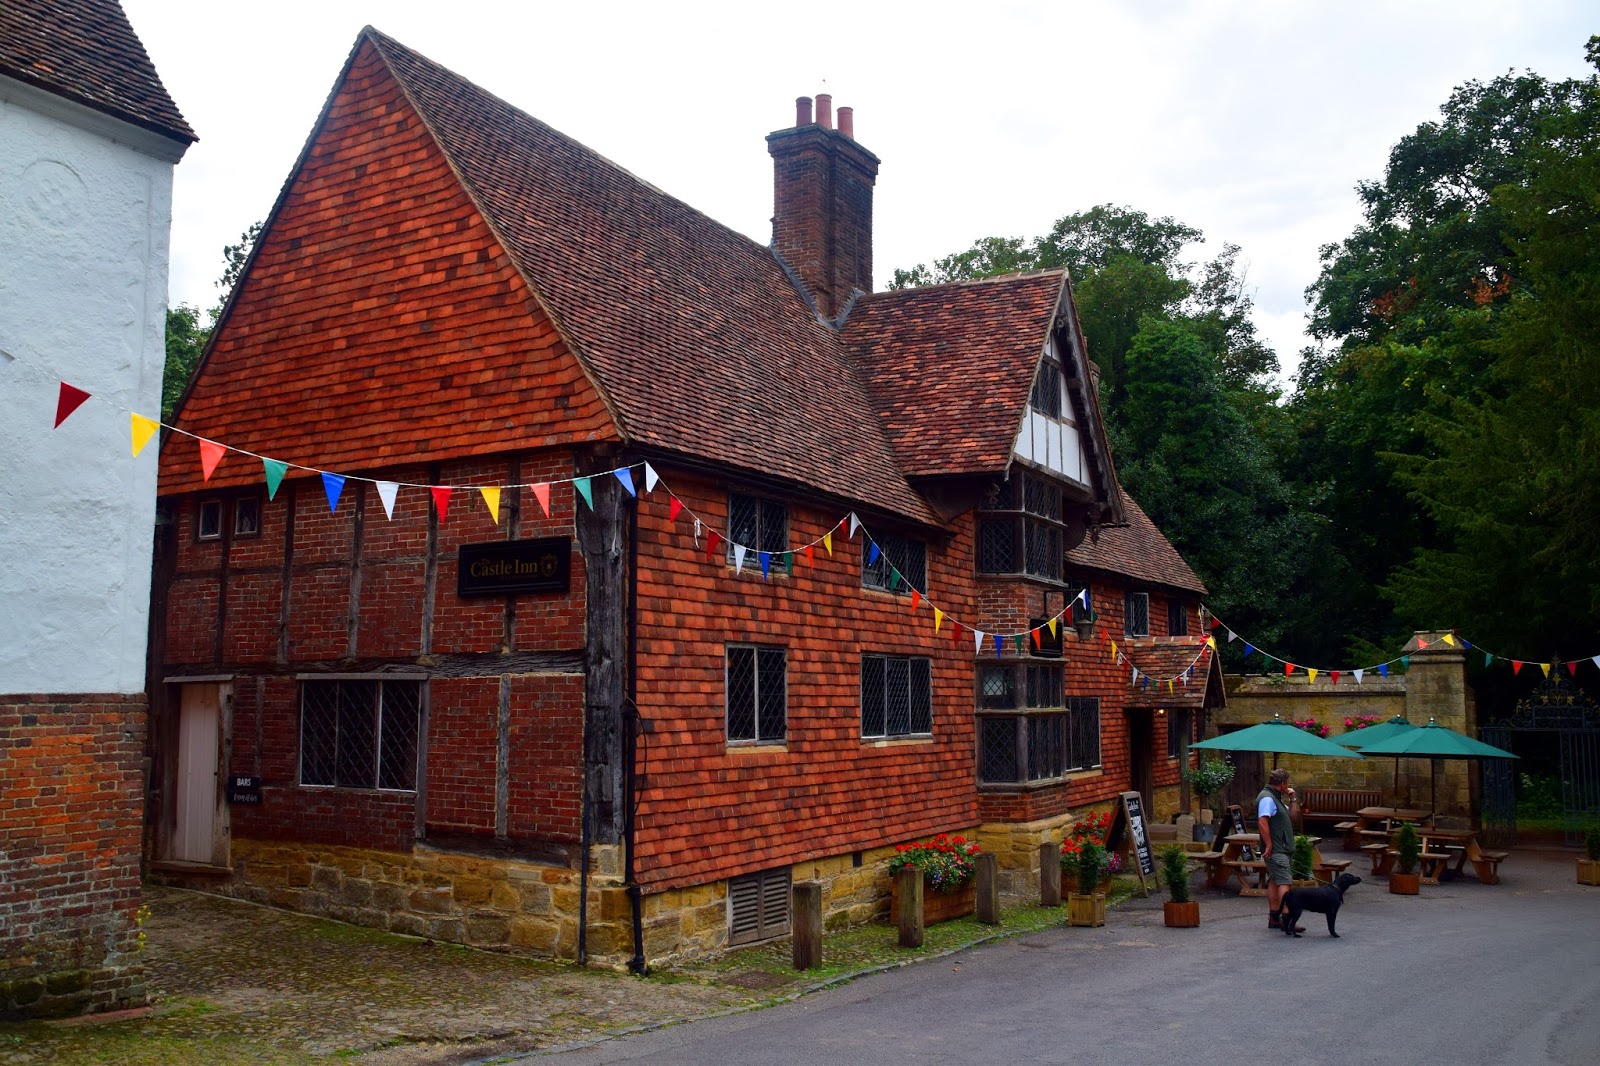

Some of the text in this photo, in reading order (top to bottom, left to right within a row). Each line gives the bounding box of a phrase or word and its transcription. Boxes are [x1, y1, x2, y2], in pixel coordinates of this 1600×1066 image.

[470, 559, 538, 577] Castle Inn
[236, 777, 251, 786] BARS
